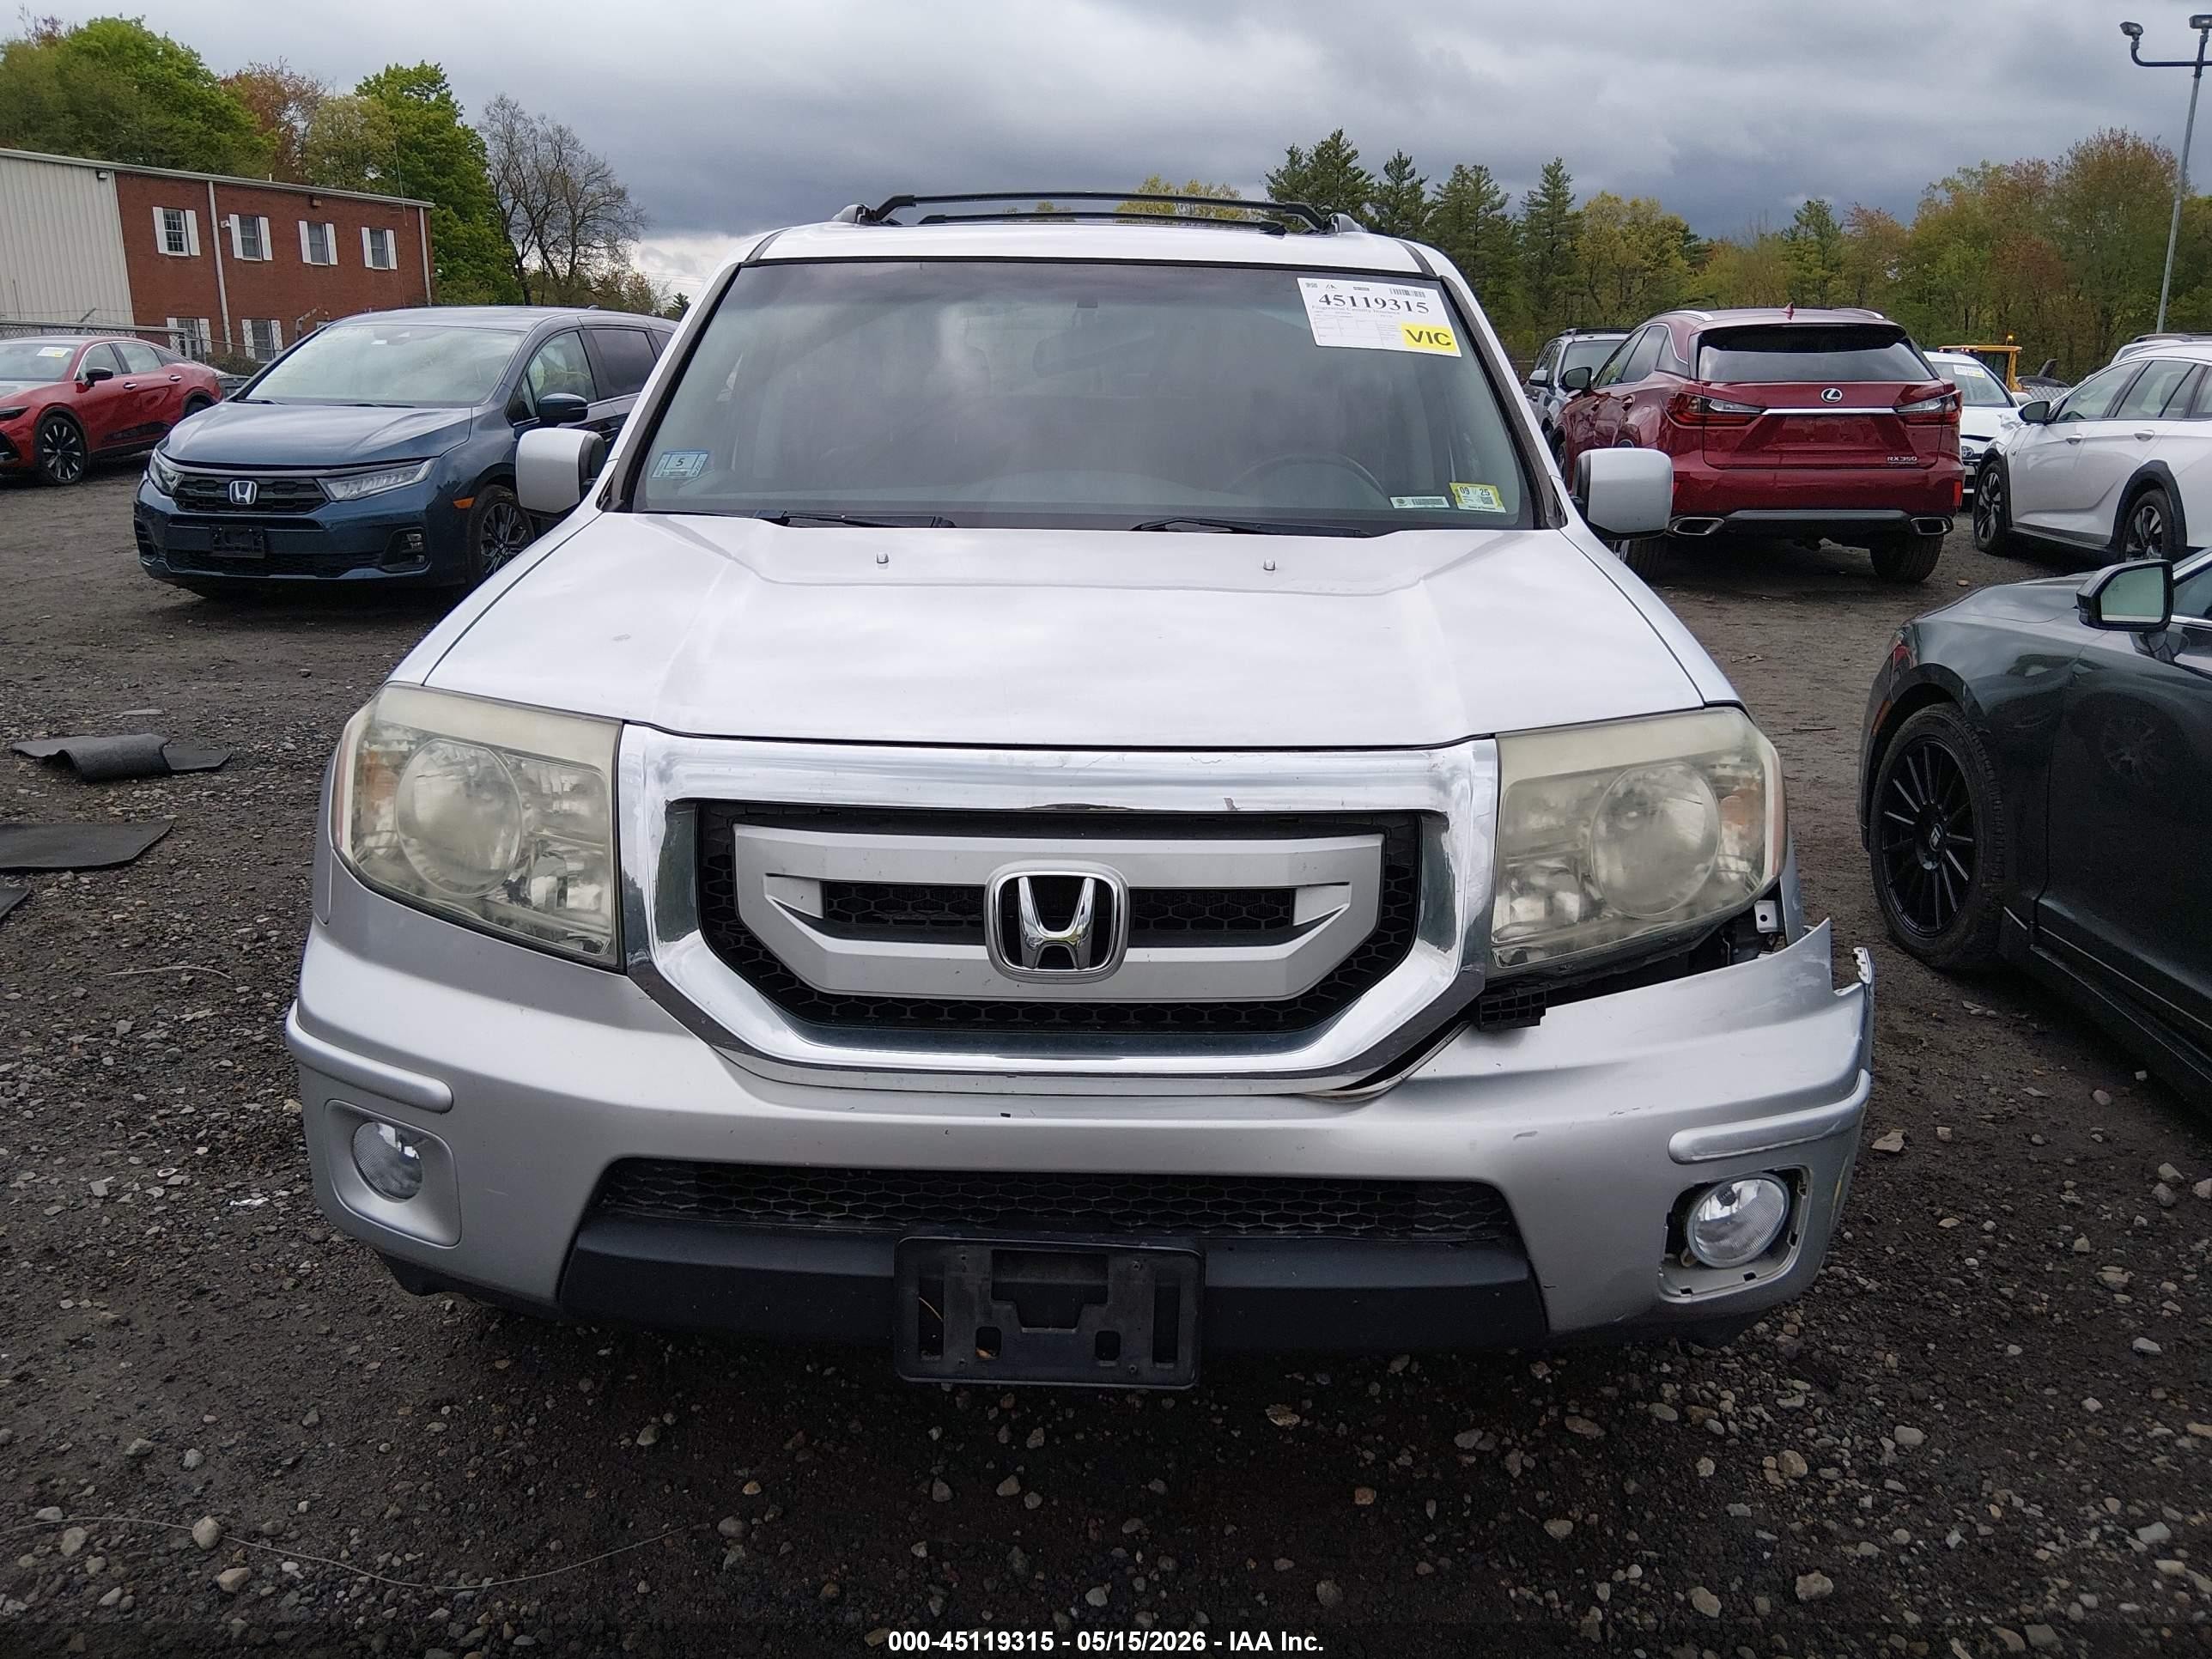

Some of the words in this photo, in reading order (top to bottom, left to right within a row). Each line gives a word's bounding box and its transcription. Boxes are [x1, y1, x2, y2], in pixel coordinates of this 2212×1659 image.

[1318, 293, 1430, 314] 45119315
[1406, 329, 1451, 346] VIC
[676, 458, 685, 466] 5
[1459, 486, 1470, 495] 09
[1479, 488, 1491, 496] 25
